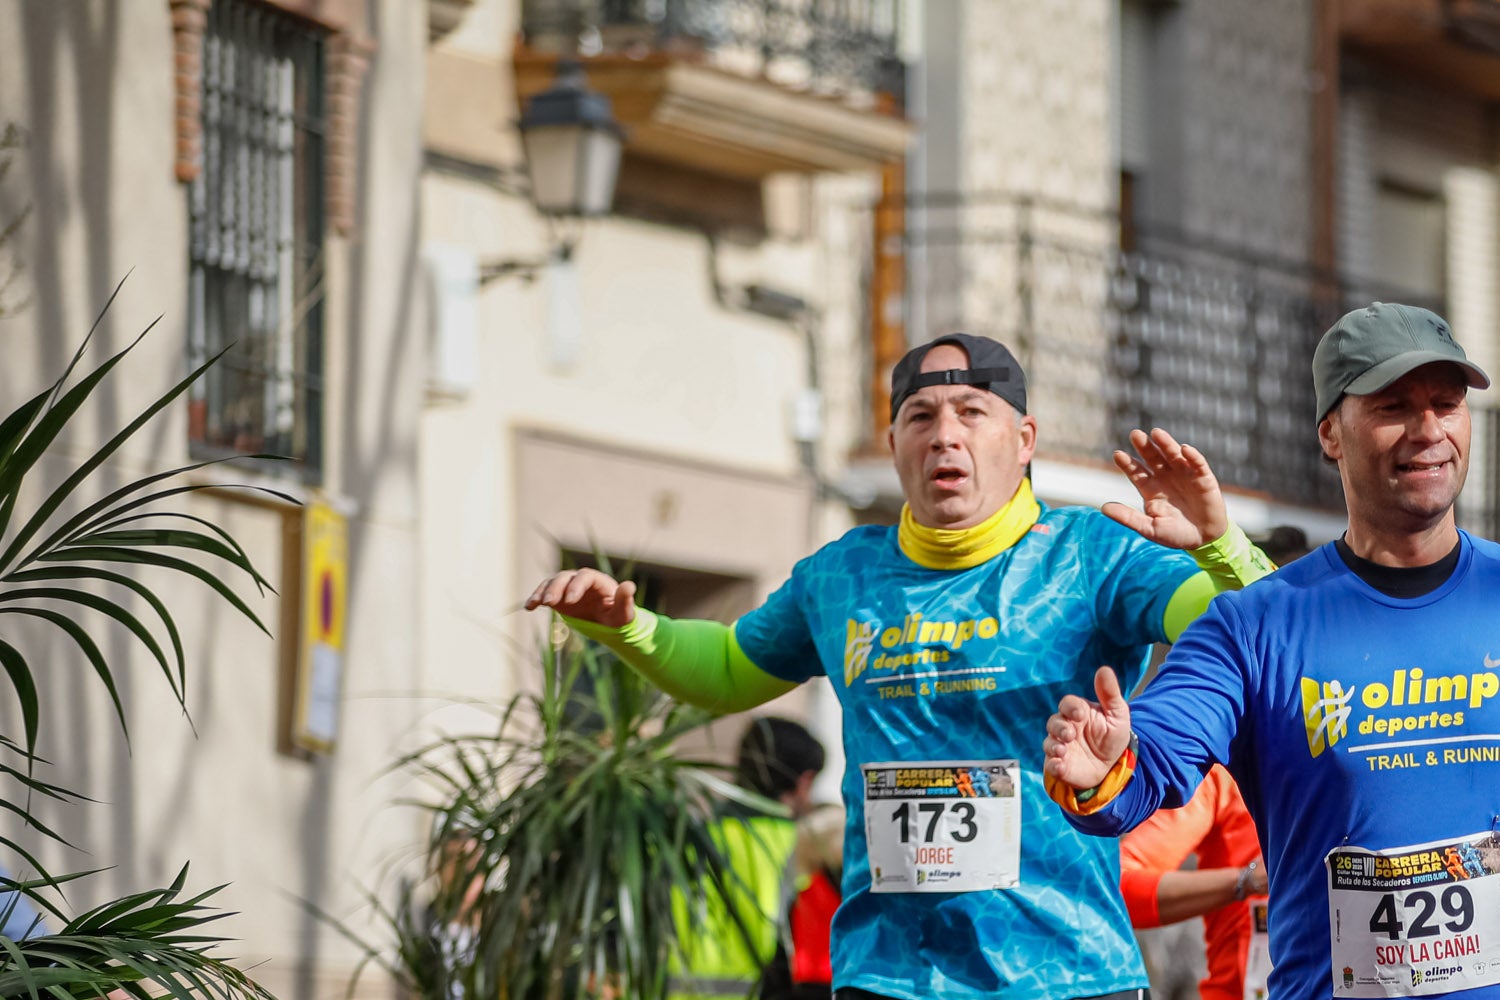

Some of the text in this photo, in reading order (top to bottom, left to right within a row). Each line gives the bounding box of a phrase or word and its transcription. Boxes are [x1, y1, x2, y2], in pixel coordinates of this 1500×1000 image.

[881, 612, 999, 649] olimpo
[873, 648, 950, 671] deportes
[878, 677, 997, 699] TRAIL & RUNNING
[1358, 711, 1465, 736] deportes
[1366, 752, 1420, 771] TRAIL
[1425, 751, 1438, 765] &
[896, 769, 952, 778] CARRERA
[896, 778, 953, 787] POPULAR
[891, 802, 978, 843] 173
[914, 847, 954, 865] JORGE
[1336, 856, 1352, 869] 26
[1375, 851, 1441, 868] CARRERA
[1375, 862, 1442, 878] POPULAR
[1337, 876, 1352, 885] Ruta
[1372, 878, 1411, 887] Secaderos
[1369, 885, 1474, 940] 429
[1375, 934, 1480, 965] SOY LA CAÑA!
[1425, 966, 1463, 976] olimpo
